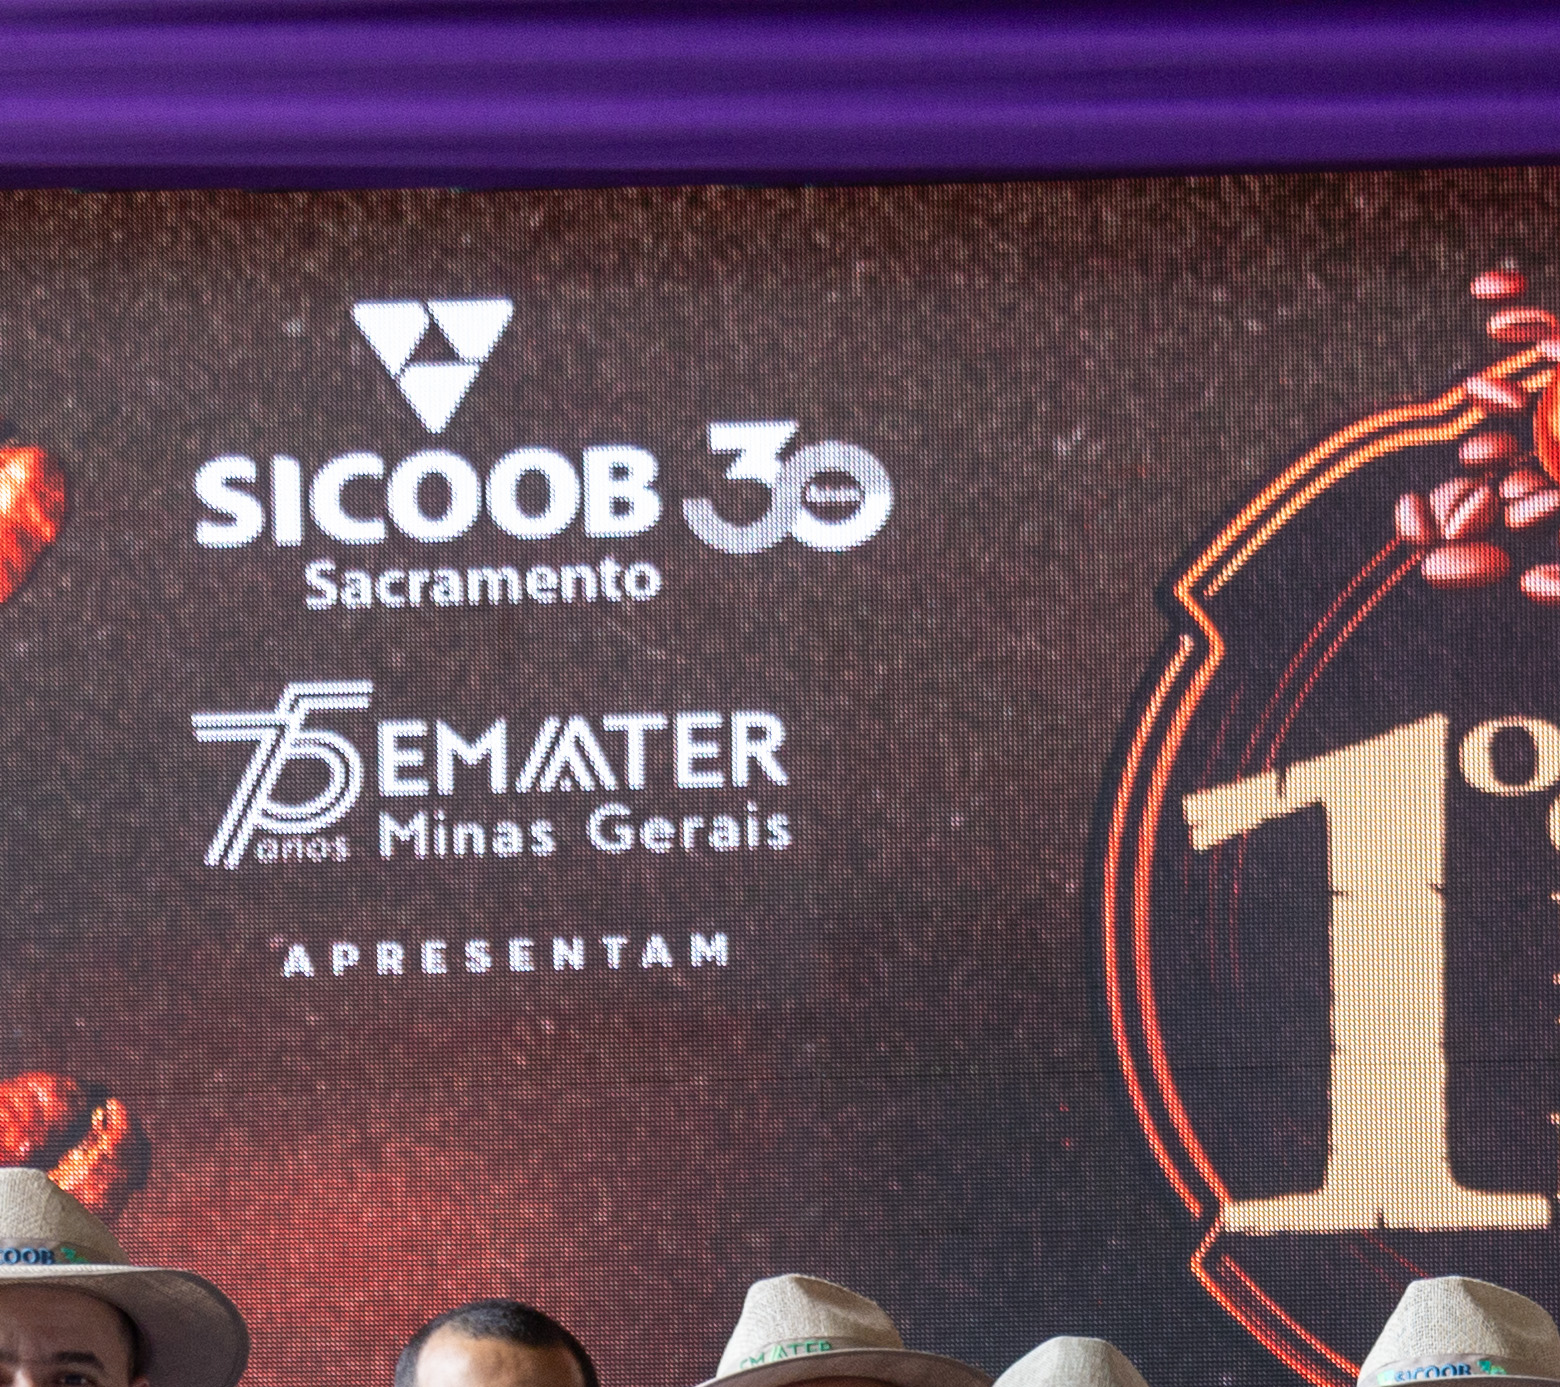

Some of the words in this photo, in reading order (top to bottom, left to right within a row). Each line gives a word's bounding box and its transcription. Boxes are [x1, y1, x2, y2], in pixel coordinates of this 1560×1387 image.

[193, 444, 663, 548] SICOOB
[682, 420, 894, 555] 30
[304, 556, 663, 611] Sacramento
[191, 681, 374, 869] 75
[377, 711, 789, 796] EMATER
[256, 834, 349, 864] anos
[378, 809, 556, 859] Minas
[587, 802, 792, 858] Gerais
[283, 933, 730, 978] APRESENTAM
